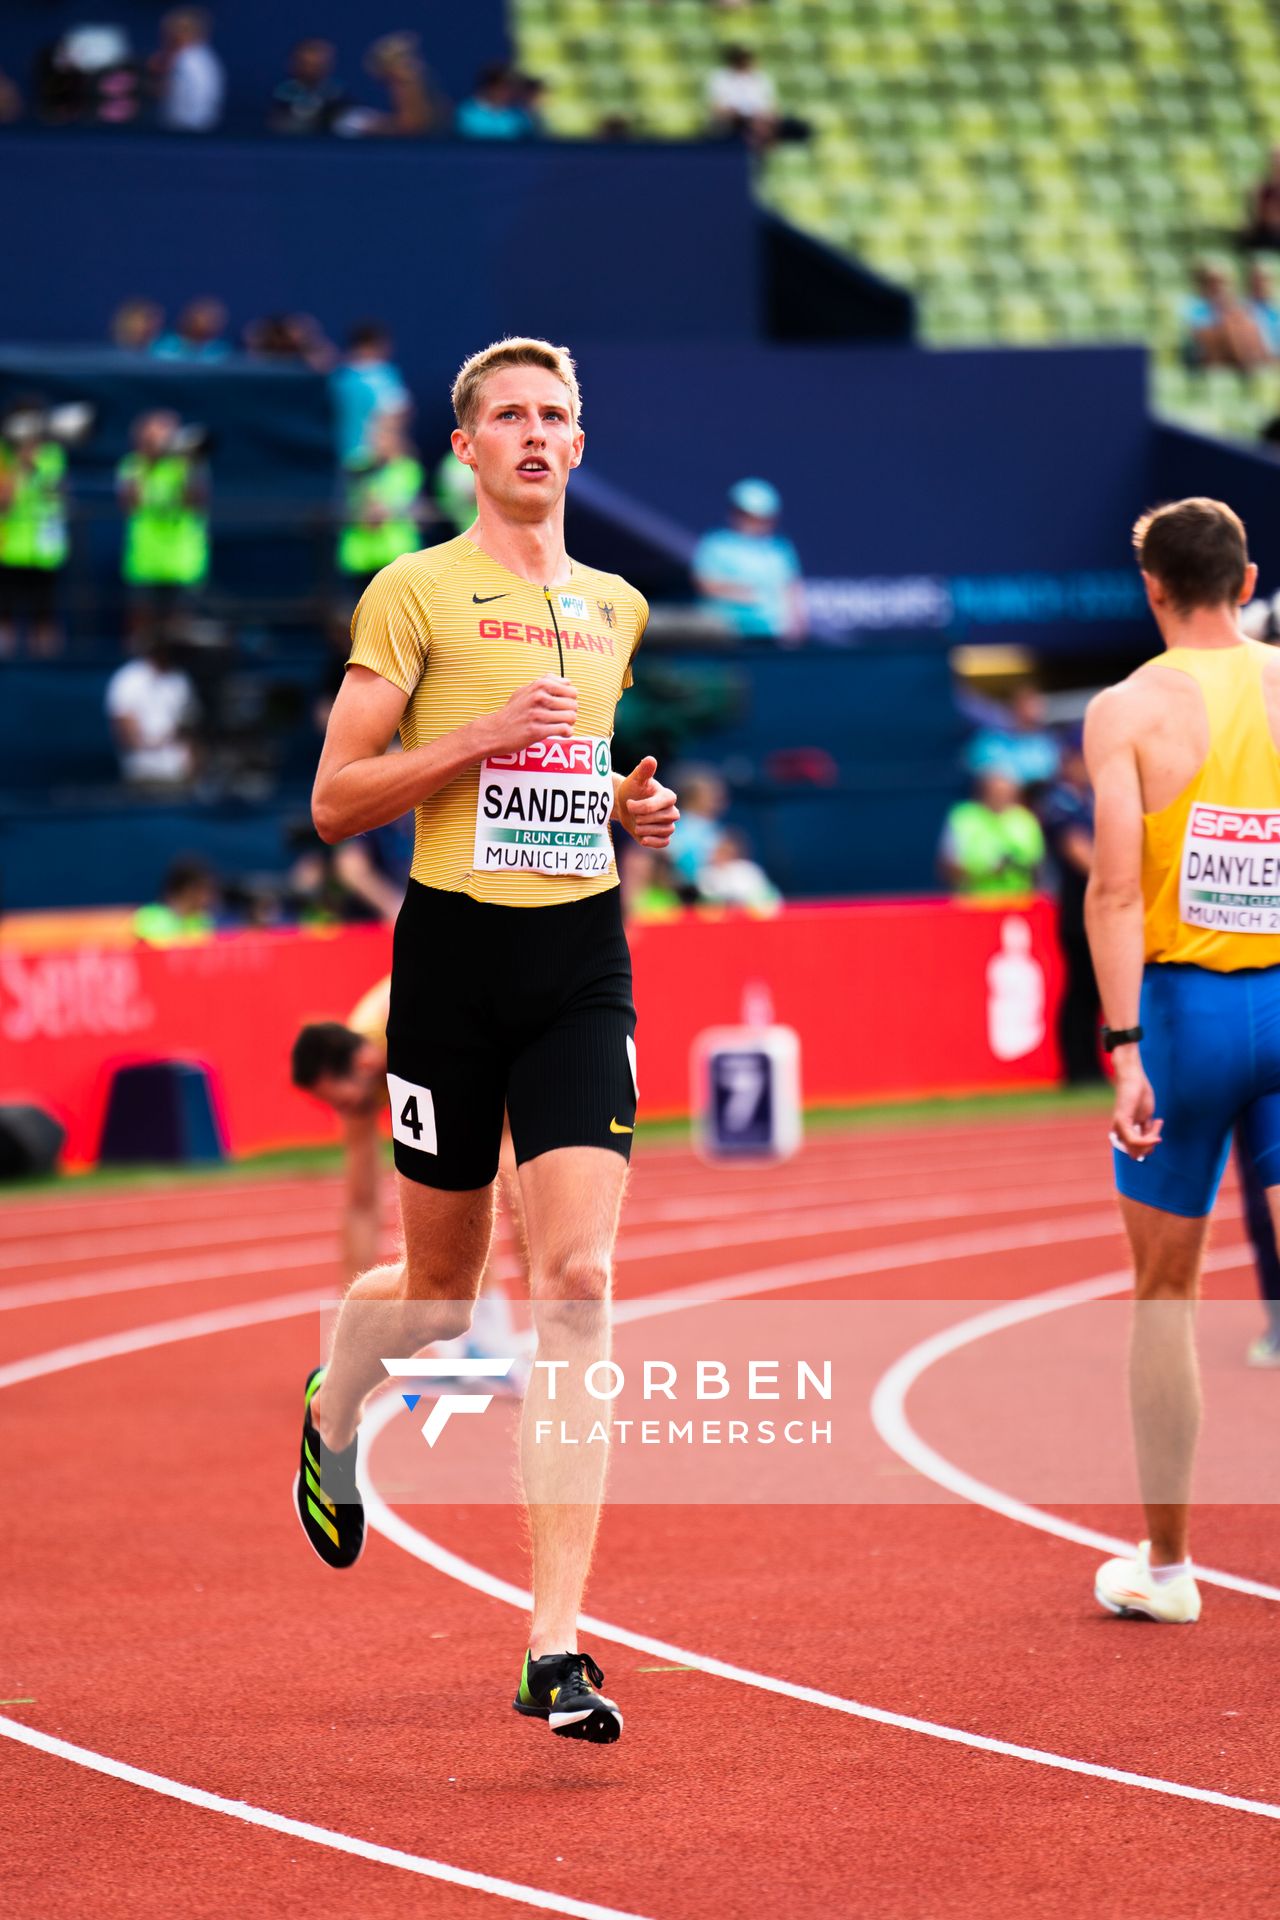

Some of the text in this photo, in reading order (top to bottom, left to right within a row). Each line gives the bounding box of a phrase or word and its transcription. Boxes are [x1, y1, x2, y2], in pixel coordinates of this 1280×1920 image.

[479, 619, 615, 656] GERMANY
[483, 784, 610, 825] SANDERS
[515, 831, 520, 843] I
[523, 831, 551, 844] RUN
[485, 846, 608, 870] MUNICH 2022
[1187, 906, 1262, 927] MUNICH
[400, 1094, 424, 1141] 4
